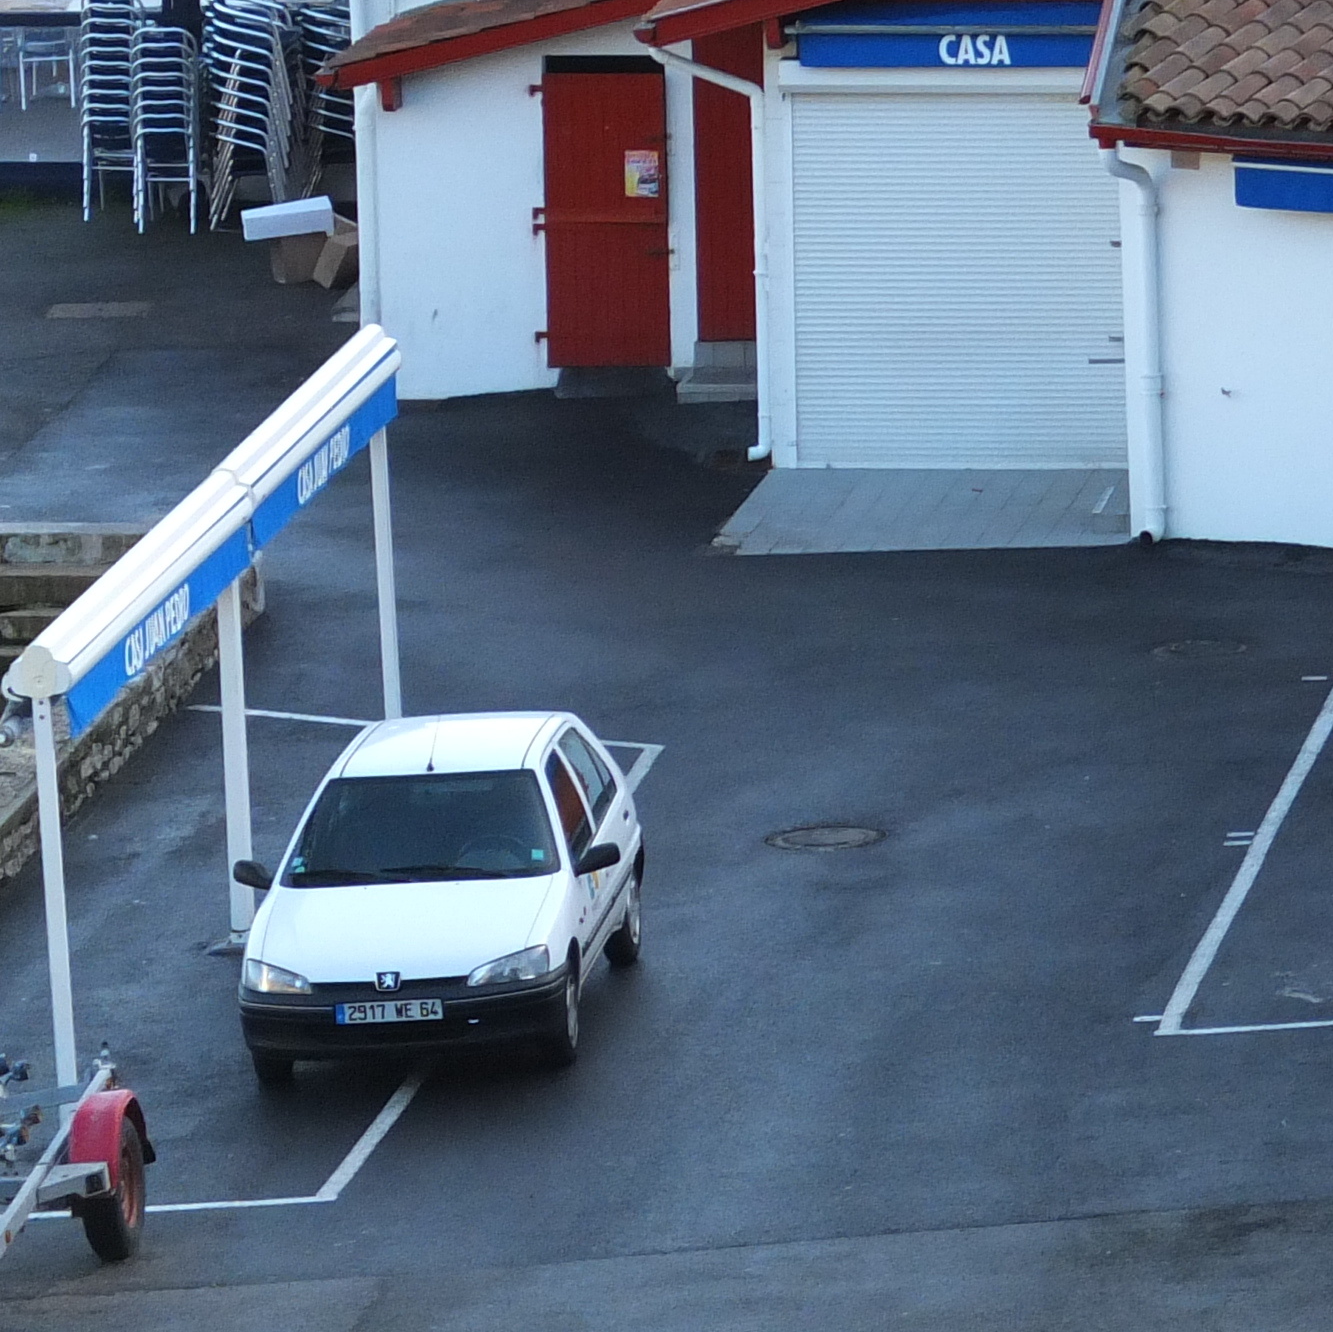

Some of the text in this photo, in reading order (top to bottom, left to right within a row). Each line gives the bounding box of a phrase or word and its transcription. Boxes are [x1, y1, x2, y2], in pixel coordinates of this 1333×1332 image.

[939, 34, 1011, 65] CASA
[348, 1005, 385, 1021] 2917
[420, 1002, 439, 1017] 64
